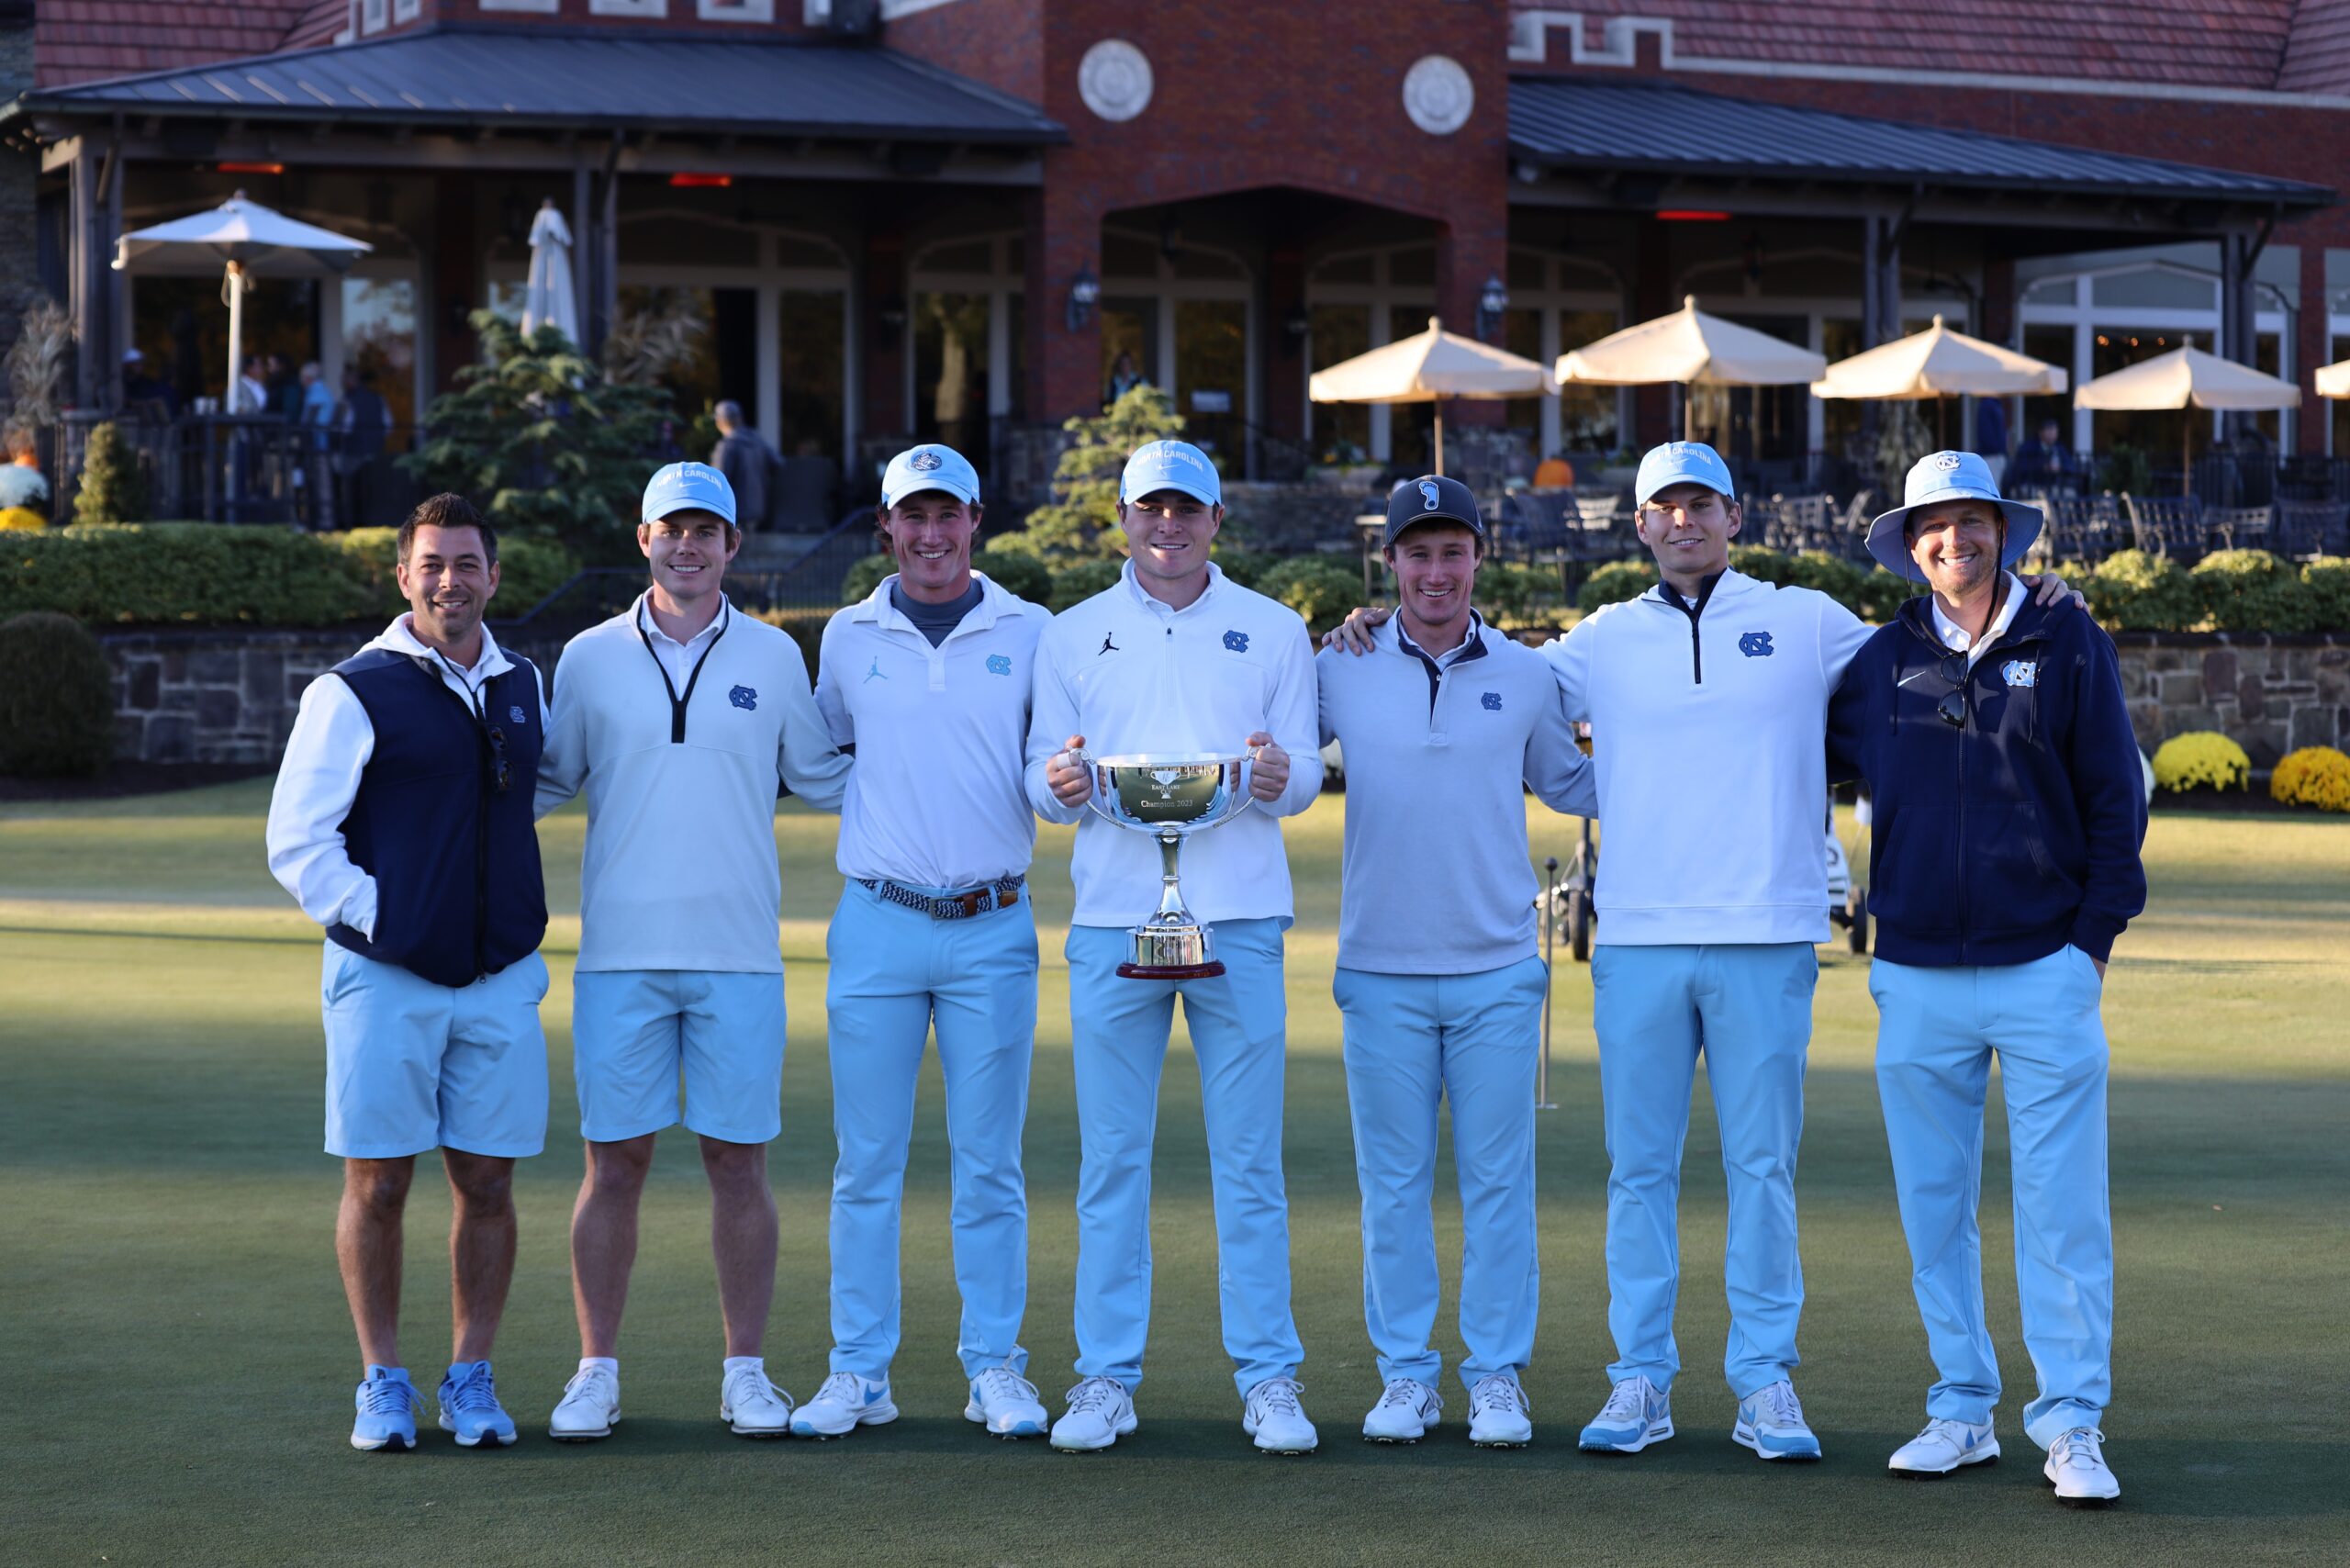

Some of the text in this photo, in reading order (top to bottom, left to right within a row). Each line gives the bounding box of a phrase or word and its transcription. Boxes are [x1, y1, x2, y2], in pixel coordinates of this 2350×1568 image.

[1136, 449, 1203, 472] NORTH CAROLINA
[1673, 447, 1712, 465] CAROLINA
[656, 469, 722, 491] NORTH CAROLINA
[1141, 799, 1192, 809] Champion 2023
